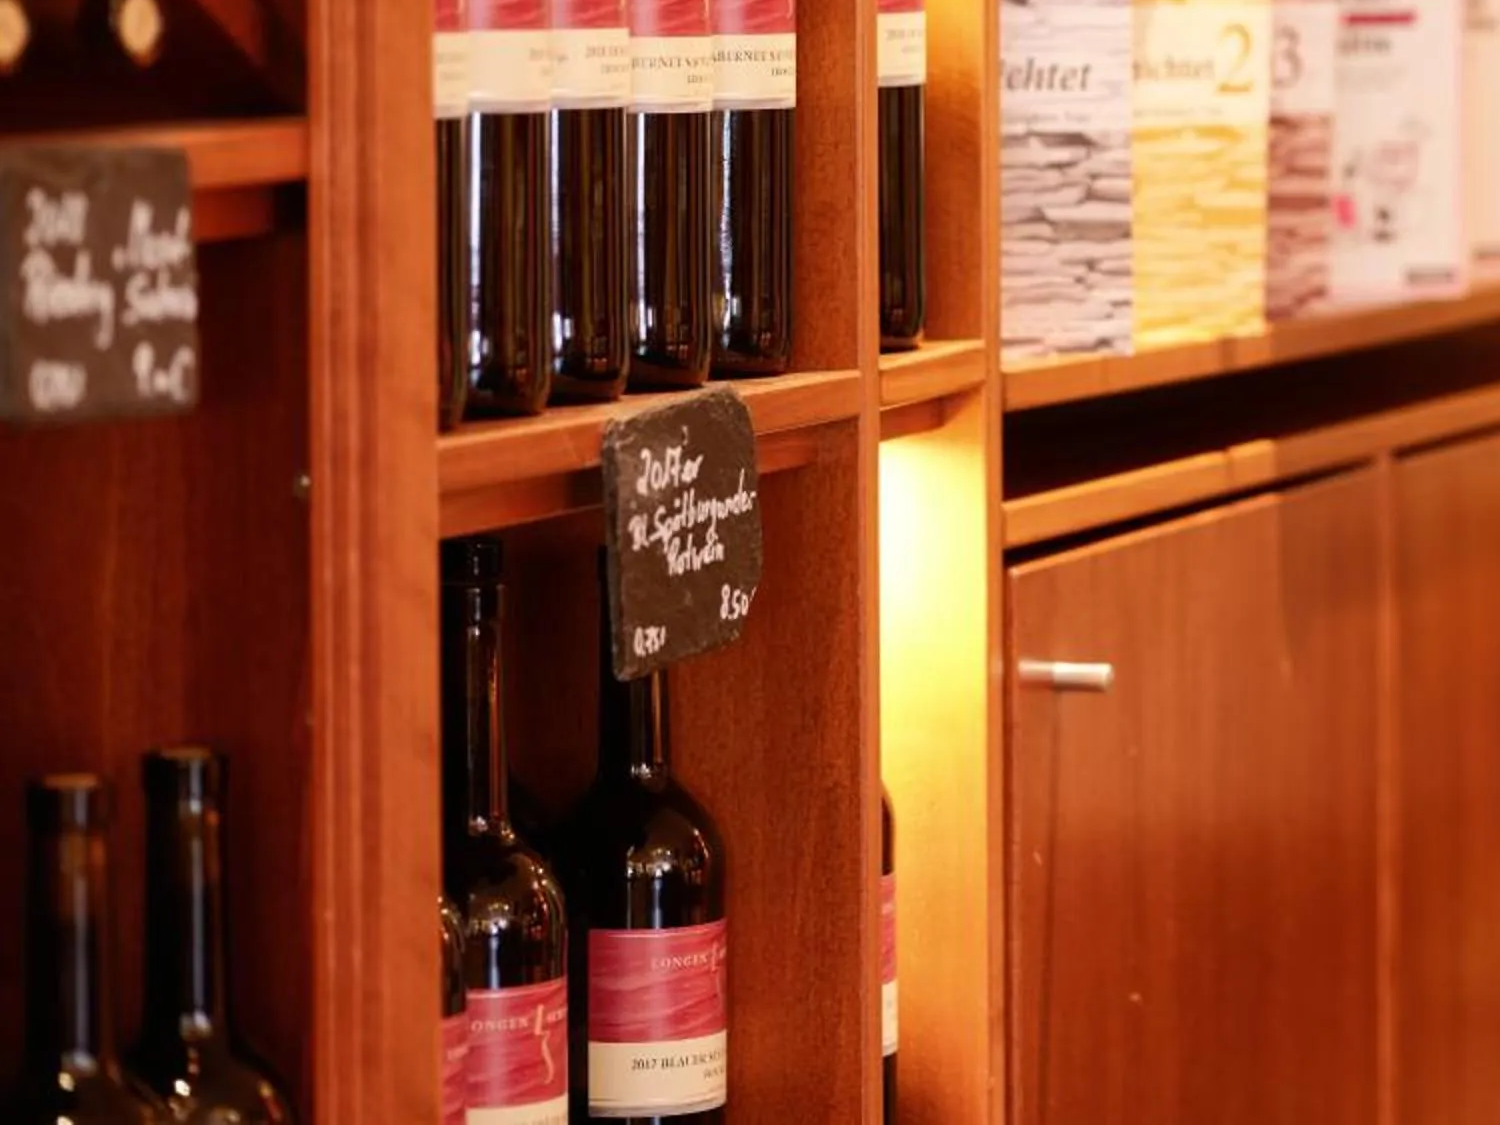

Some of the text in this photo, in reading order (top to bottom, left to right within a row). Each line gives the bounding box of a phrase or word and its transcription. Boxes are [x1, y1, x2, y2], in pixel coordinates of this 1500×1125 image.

[1216, 22, 1253, 95] 2
[1272, 24, 1303, 90] 3
[630, 1057, 658, 1072] 2017
